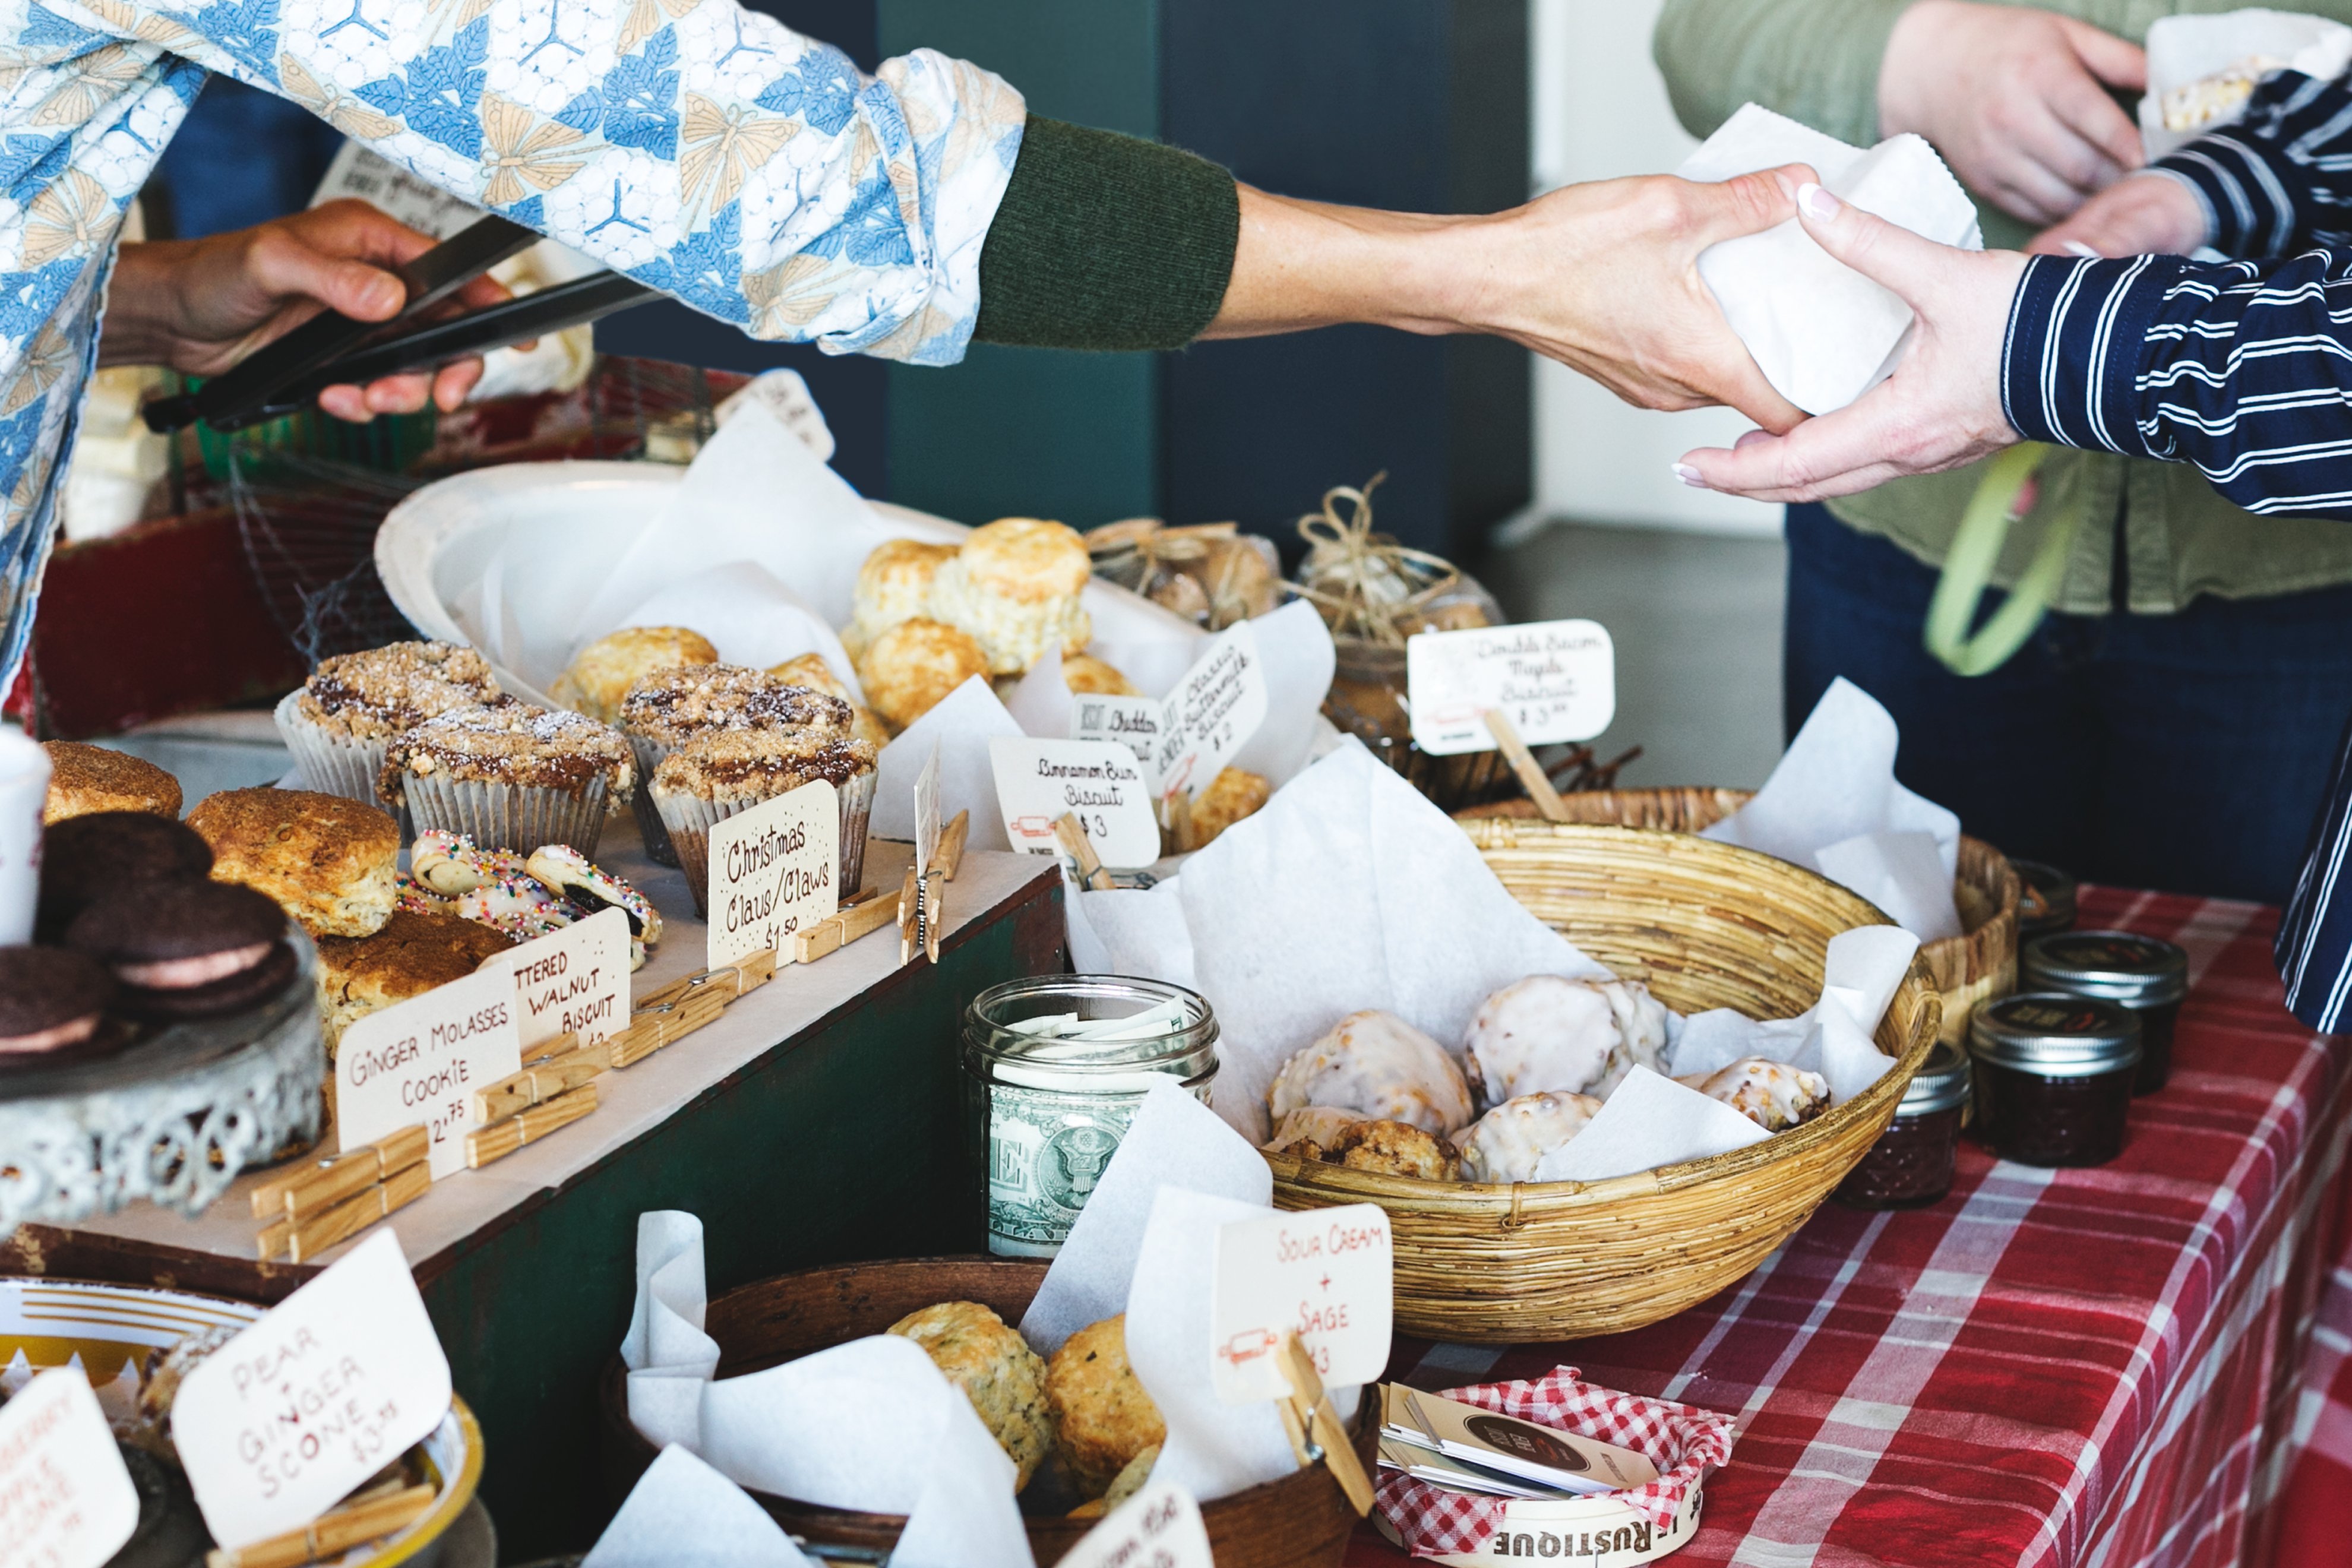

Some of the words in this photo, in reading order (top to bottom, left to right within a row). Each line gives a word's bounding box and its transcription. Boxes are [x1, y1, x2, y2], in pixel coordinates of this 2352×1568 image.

[1037, 758, 1105, 779] Cinnamon
[1105, 760, 1137, 780] Bun
[1064, 783, 1124, 807] Biscuit
[728, 821, 805, 883] Christmas
[726, 861, 829, 932] Claus/Claws
[765, 916, 798, 951] $1.50
[514, 951, 567, 990] TTERED
[529, 968, 600, 1016] WALNUT
[431, 1002, 508, 1051] MOLASSES
[562, 993, 615, 1034] BISCUIT
[433, 1099, 464, 1143] 2.75
[1278, 1228, 1323, 1264] SOUR
[1328, 1224, 1383, 1254] CREAM
[1297, 1300, 1349, 1336] SAGE
[230, 1326, 321, 1402] PEAR
[239, 1355, 366, 1464] GINGER
[257, 1398, 365, 1499] SCONE
[1493, 1520, 1652, 1558] RUSTIQUE
